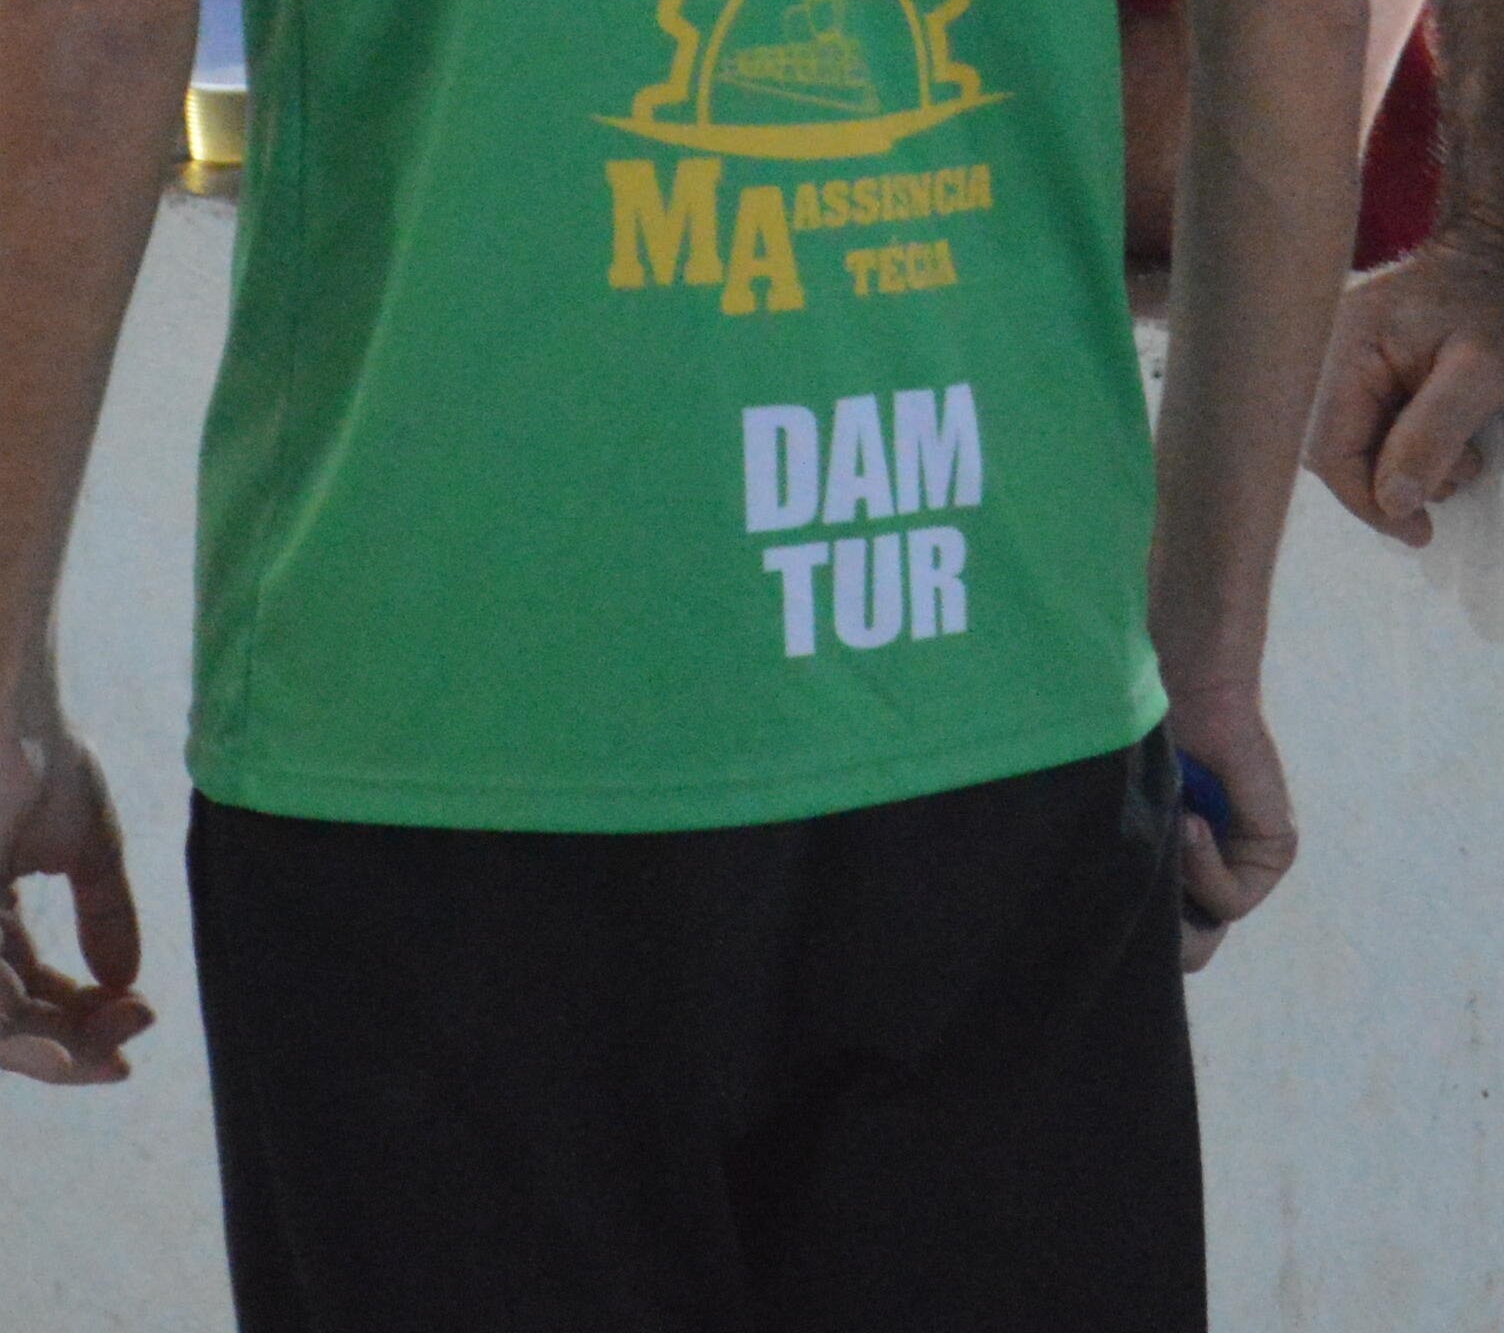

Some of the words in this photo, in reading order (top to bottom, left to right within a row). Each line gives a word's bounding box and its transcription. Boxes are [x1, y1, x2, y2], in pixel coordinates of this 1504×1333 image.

[604, 157, 805, 315] MA
[742, 382, 983, 534] DAM
[763, 525, 969, 659] TUR
